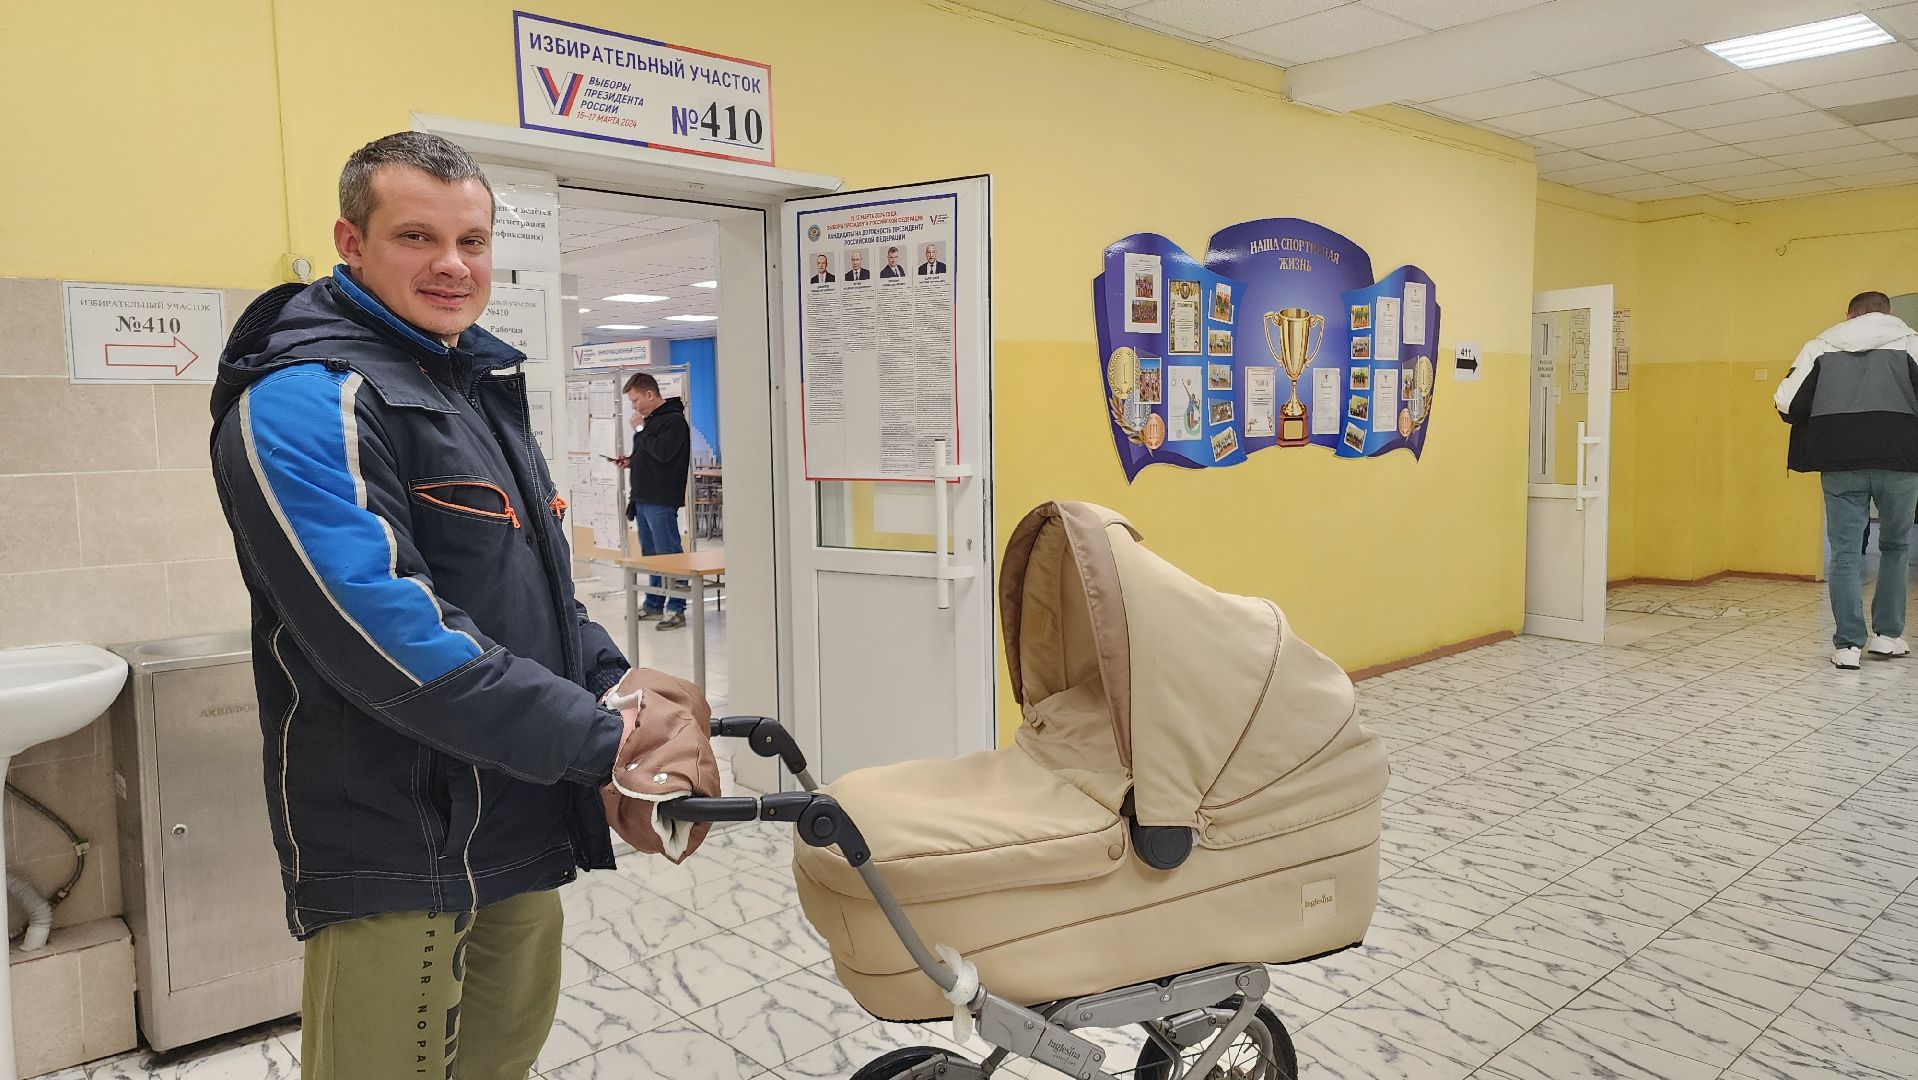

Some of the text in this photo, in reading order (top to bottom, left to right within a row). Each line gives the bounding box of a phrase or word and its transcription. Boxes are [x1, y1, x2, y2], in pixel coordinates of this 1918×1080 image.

[529, 32, 761, 94] ИЗБИРАТЕЛЬНЫЙ УЧАСТОК
[588, 76, 632, 92] ВЫБОРЫ
[584, 88, 644, 107] ПРЕЗИДЕНТА
[580, 99, 620, 115] РОССИИ
[596, 114, 620, 126] МАРТА
[621, 118, 638, 129] 2024
[492, 230, 544, 243] офиксация)
[1249, 237, 1340, 265] НАША СПОРТИВНАЯ
[1278, 257, 1313, 272] ЖИЗНЬ
[80, 298, 212, 312] ИЗБИРАТЕЛЬНЫЙ УЧАСТОК
[485, 307, 509, 317] №410
[115, 315, 181, 334] №410
[490, 325, 523, 334] Рабочая
[420, 930, 436, 984] FEAR
[416, 1005, 428, 1030] NO
[1047, 1038, 1081, 1060] Inglesina
